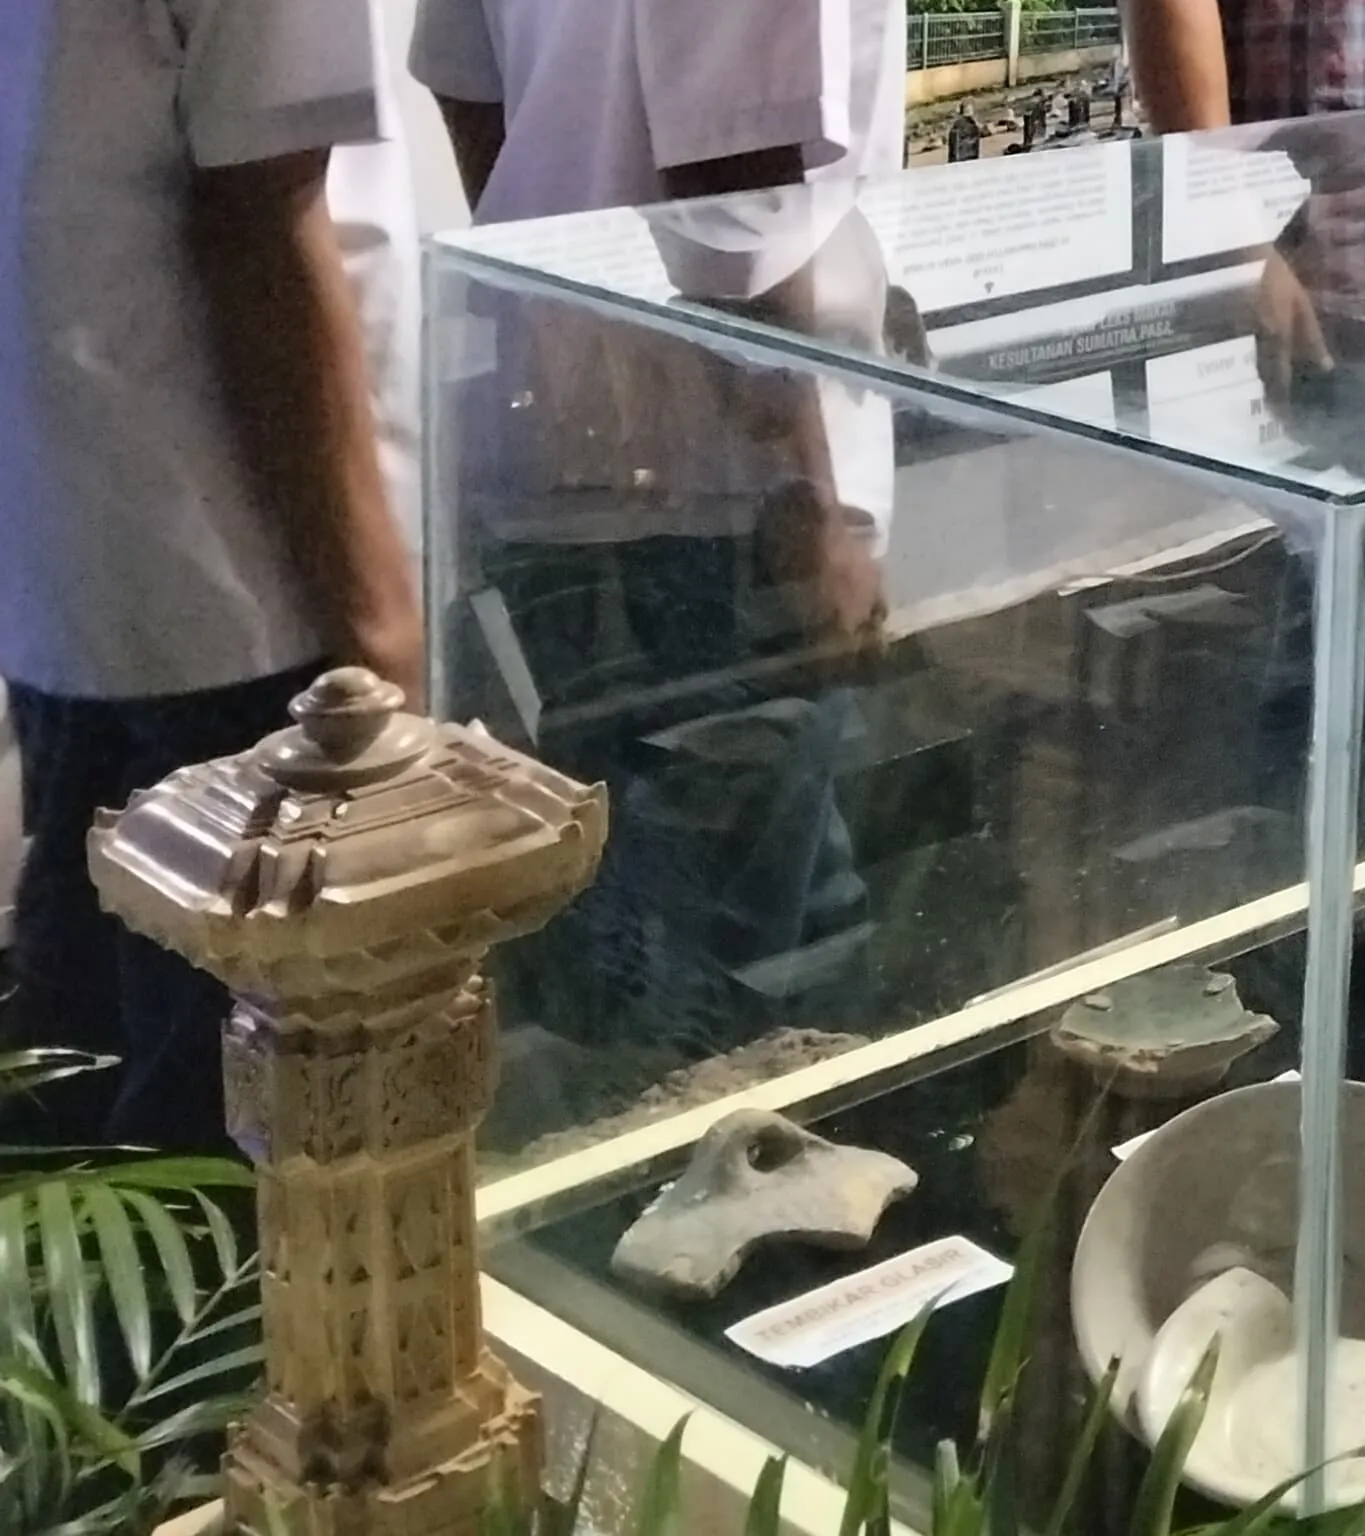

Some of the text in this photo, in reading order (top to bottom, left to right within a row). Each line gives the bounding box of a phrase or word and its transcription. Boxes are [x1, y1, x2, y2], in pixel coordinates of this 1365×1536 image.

[988, 336, 1073, 369] KESULTANAN
[1075, 326, 1137, 354] SUMATRA
[754, 1248, 964, 1341] TEMBIKAR GLASIR
